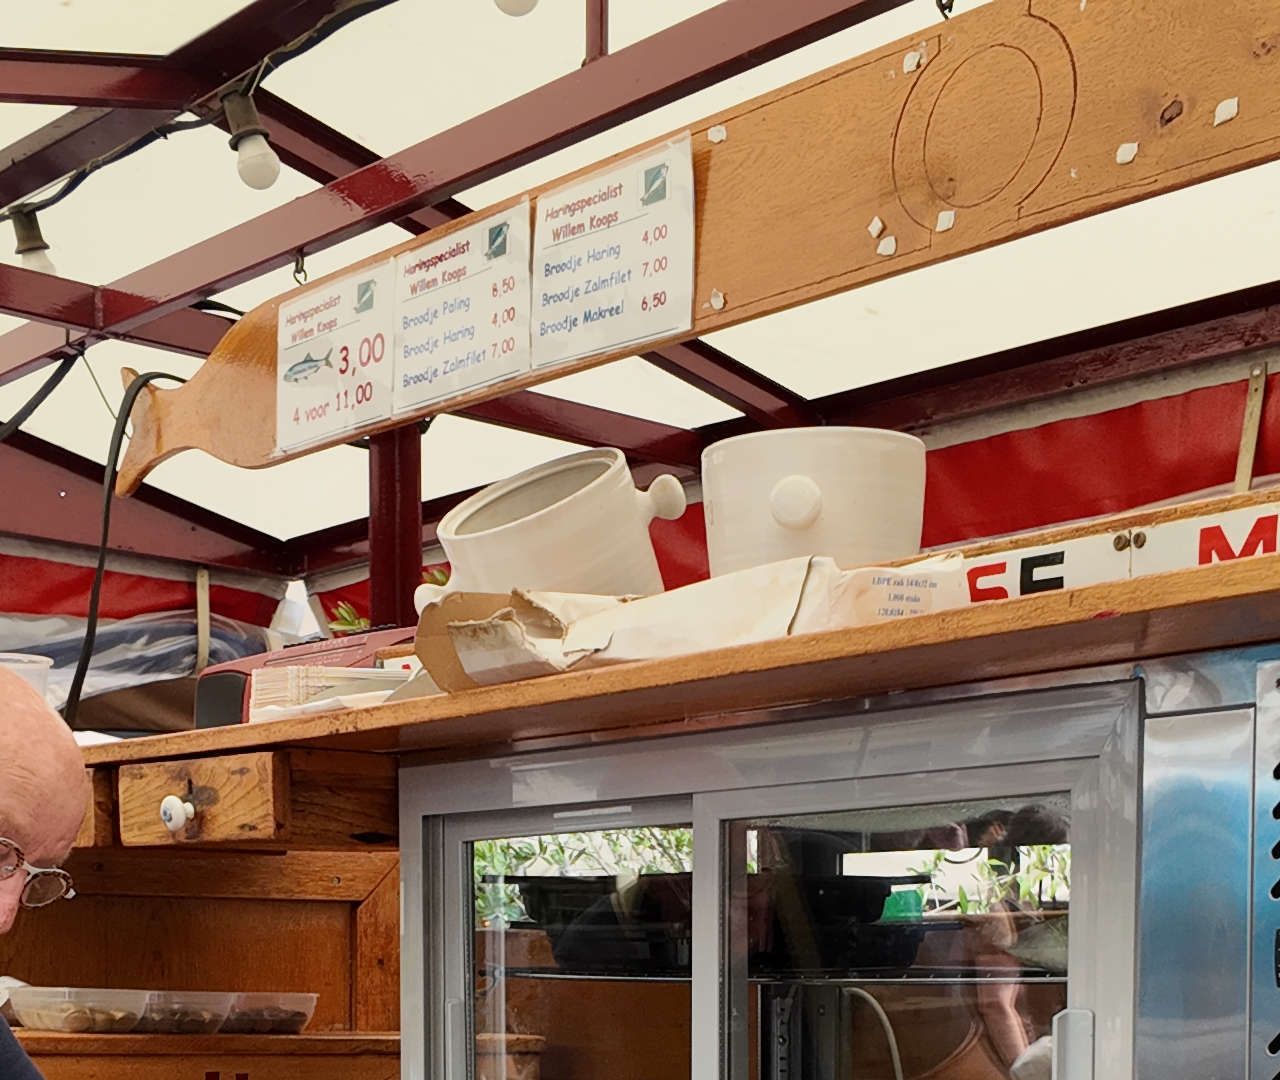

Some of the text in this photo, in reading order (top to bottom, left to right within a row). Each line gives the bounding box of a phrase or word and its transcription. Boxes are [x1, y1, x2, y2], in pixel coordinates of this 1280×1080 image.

[545, 182, 624, 222] Haringspecialist
[552, 210, 619, 242] Willem Koops
[403, 240, 471, 277] Haringspecialist
[545, 224, 668, 277] Broodje Haring 4,00
[410, 266, 467, 295] Willem Koops
[542, 256, 668, 307] Broodje Zalmfilet 7,00
[285, 295, 342, 327] Haringspecialist
[402, 276, 515, 330] Broodje Paling 8,50
[540, 290, 666, 336] Broodje Makreel 6,50
[291, 317, 338, 345] Willem Koops
[403, 307, 515, 359] Broodje Haring 4,00
[338, 333, 386, 377] 3,00
[402, 337, 515, 388] Broodje Zalmfilet 7,00
[293, 382, 373, 425] 4 voor 11,00
